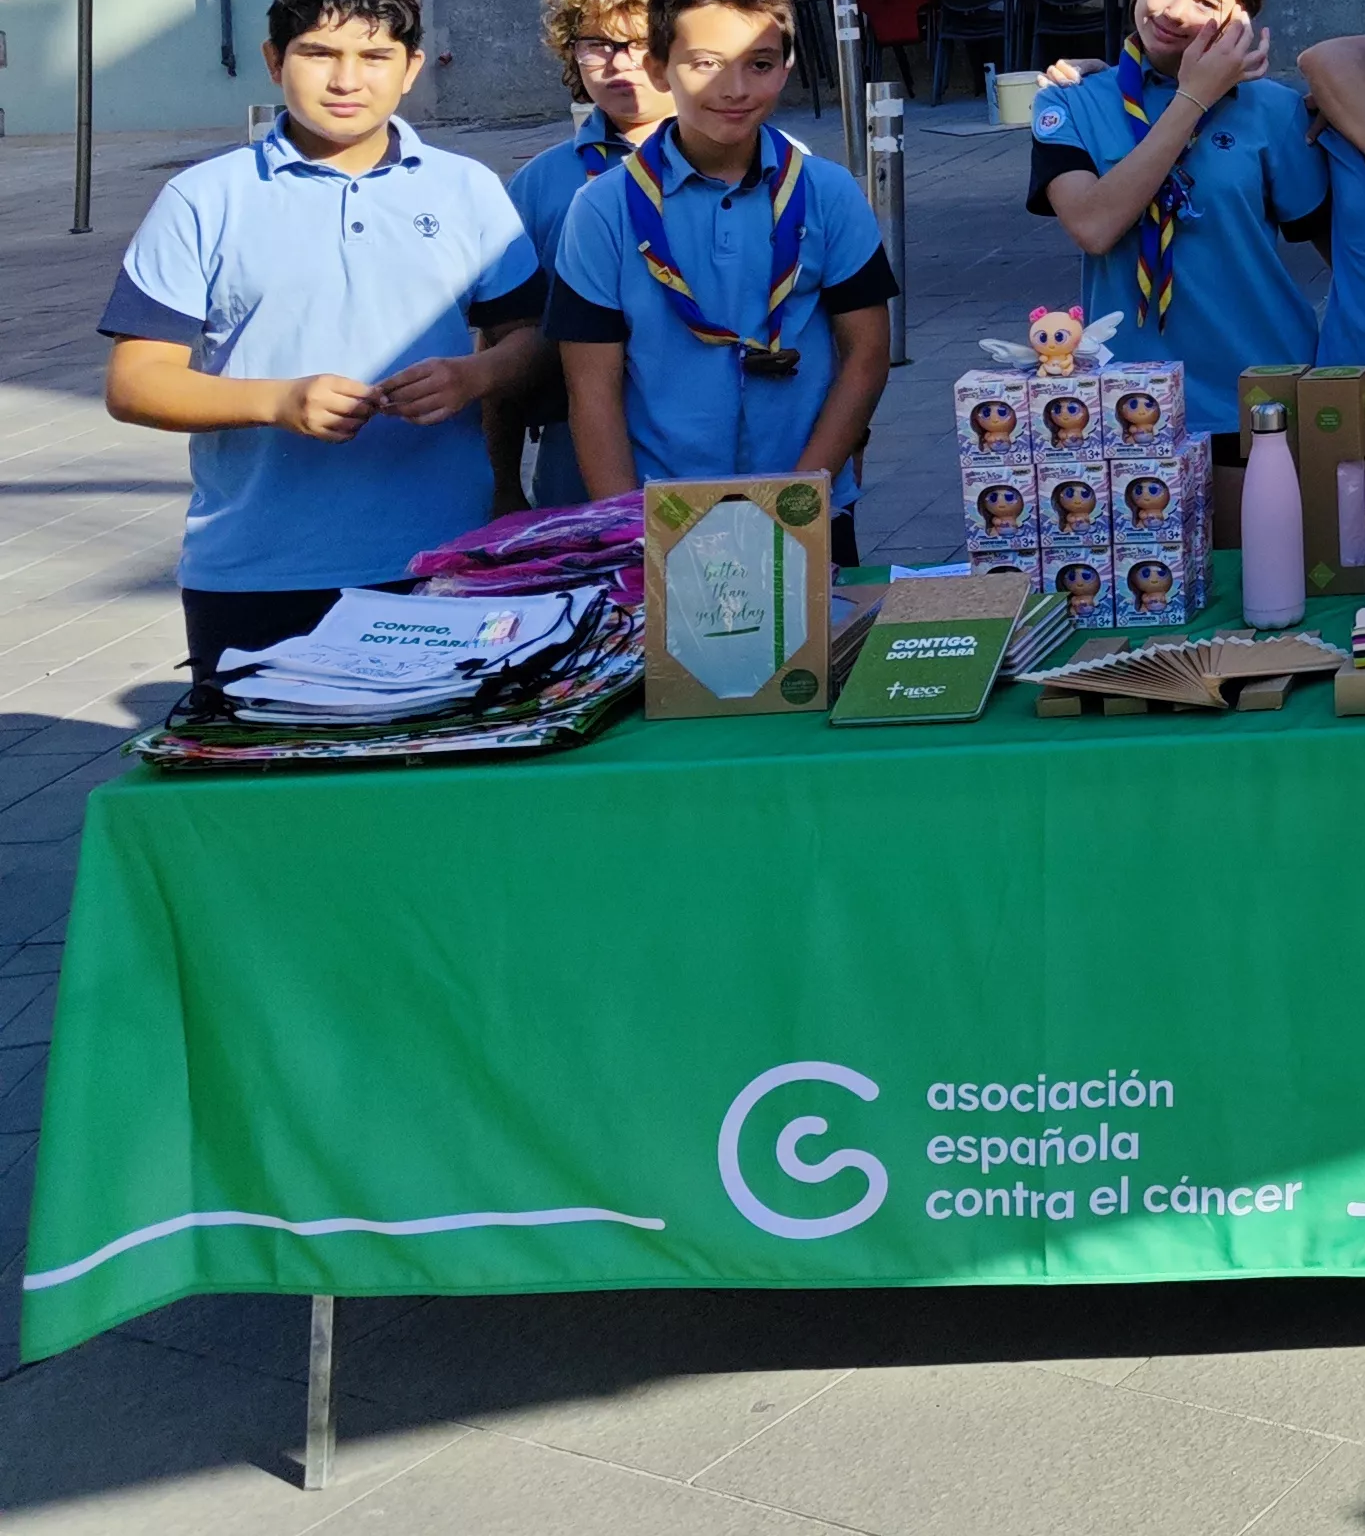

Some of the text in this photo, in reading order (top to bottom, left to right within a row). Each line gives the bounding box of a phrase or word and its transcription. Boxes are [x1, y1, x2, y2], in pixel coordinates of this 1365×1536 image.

[1087, 450, 1100, 460] 3+
[1158, 446, 1170, 457] 3+
[1015, 453, 1028, 464] 3+
[1094, 534, 1107, 544] 3+
[1167, 531, 1180, 541] 3+
[1022, 538, 1035, 548] 3+
[703, 561, 749, 584] better
[711, 582, 749, 601] than
[695, 602, 765, 624] yesterday
[1169, 614, 1182, 624] 3+
[1098, 617, 1111, 627] 3+
[372, 621, 452, 636] CONTIGO,
[360, 633, 398, 643] DOY
[399, 636, 421, 645] LA
[891, 635, 979, 650] CONTIGO,
[885, 647, 975, 661] DOY LA CARA
[903, 685, 947, 696] aecc
[926, 1068, 1175, 1113] asociación
[926, 1123, 1140, 1174] española
[925, 1175, 1303, 1221] contra el cáncer
